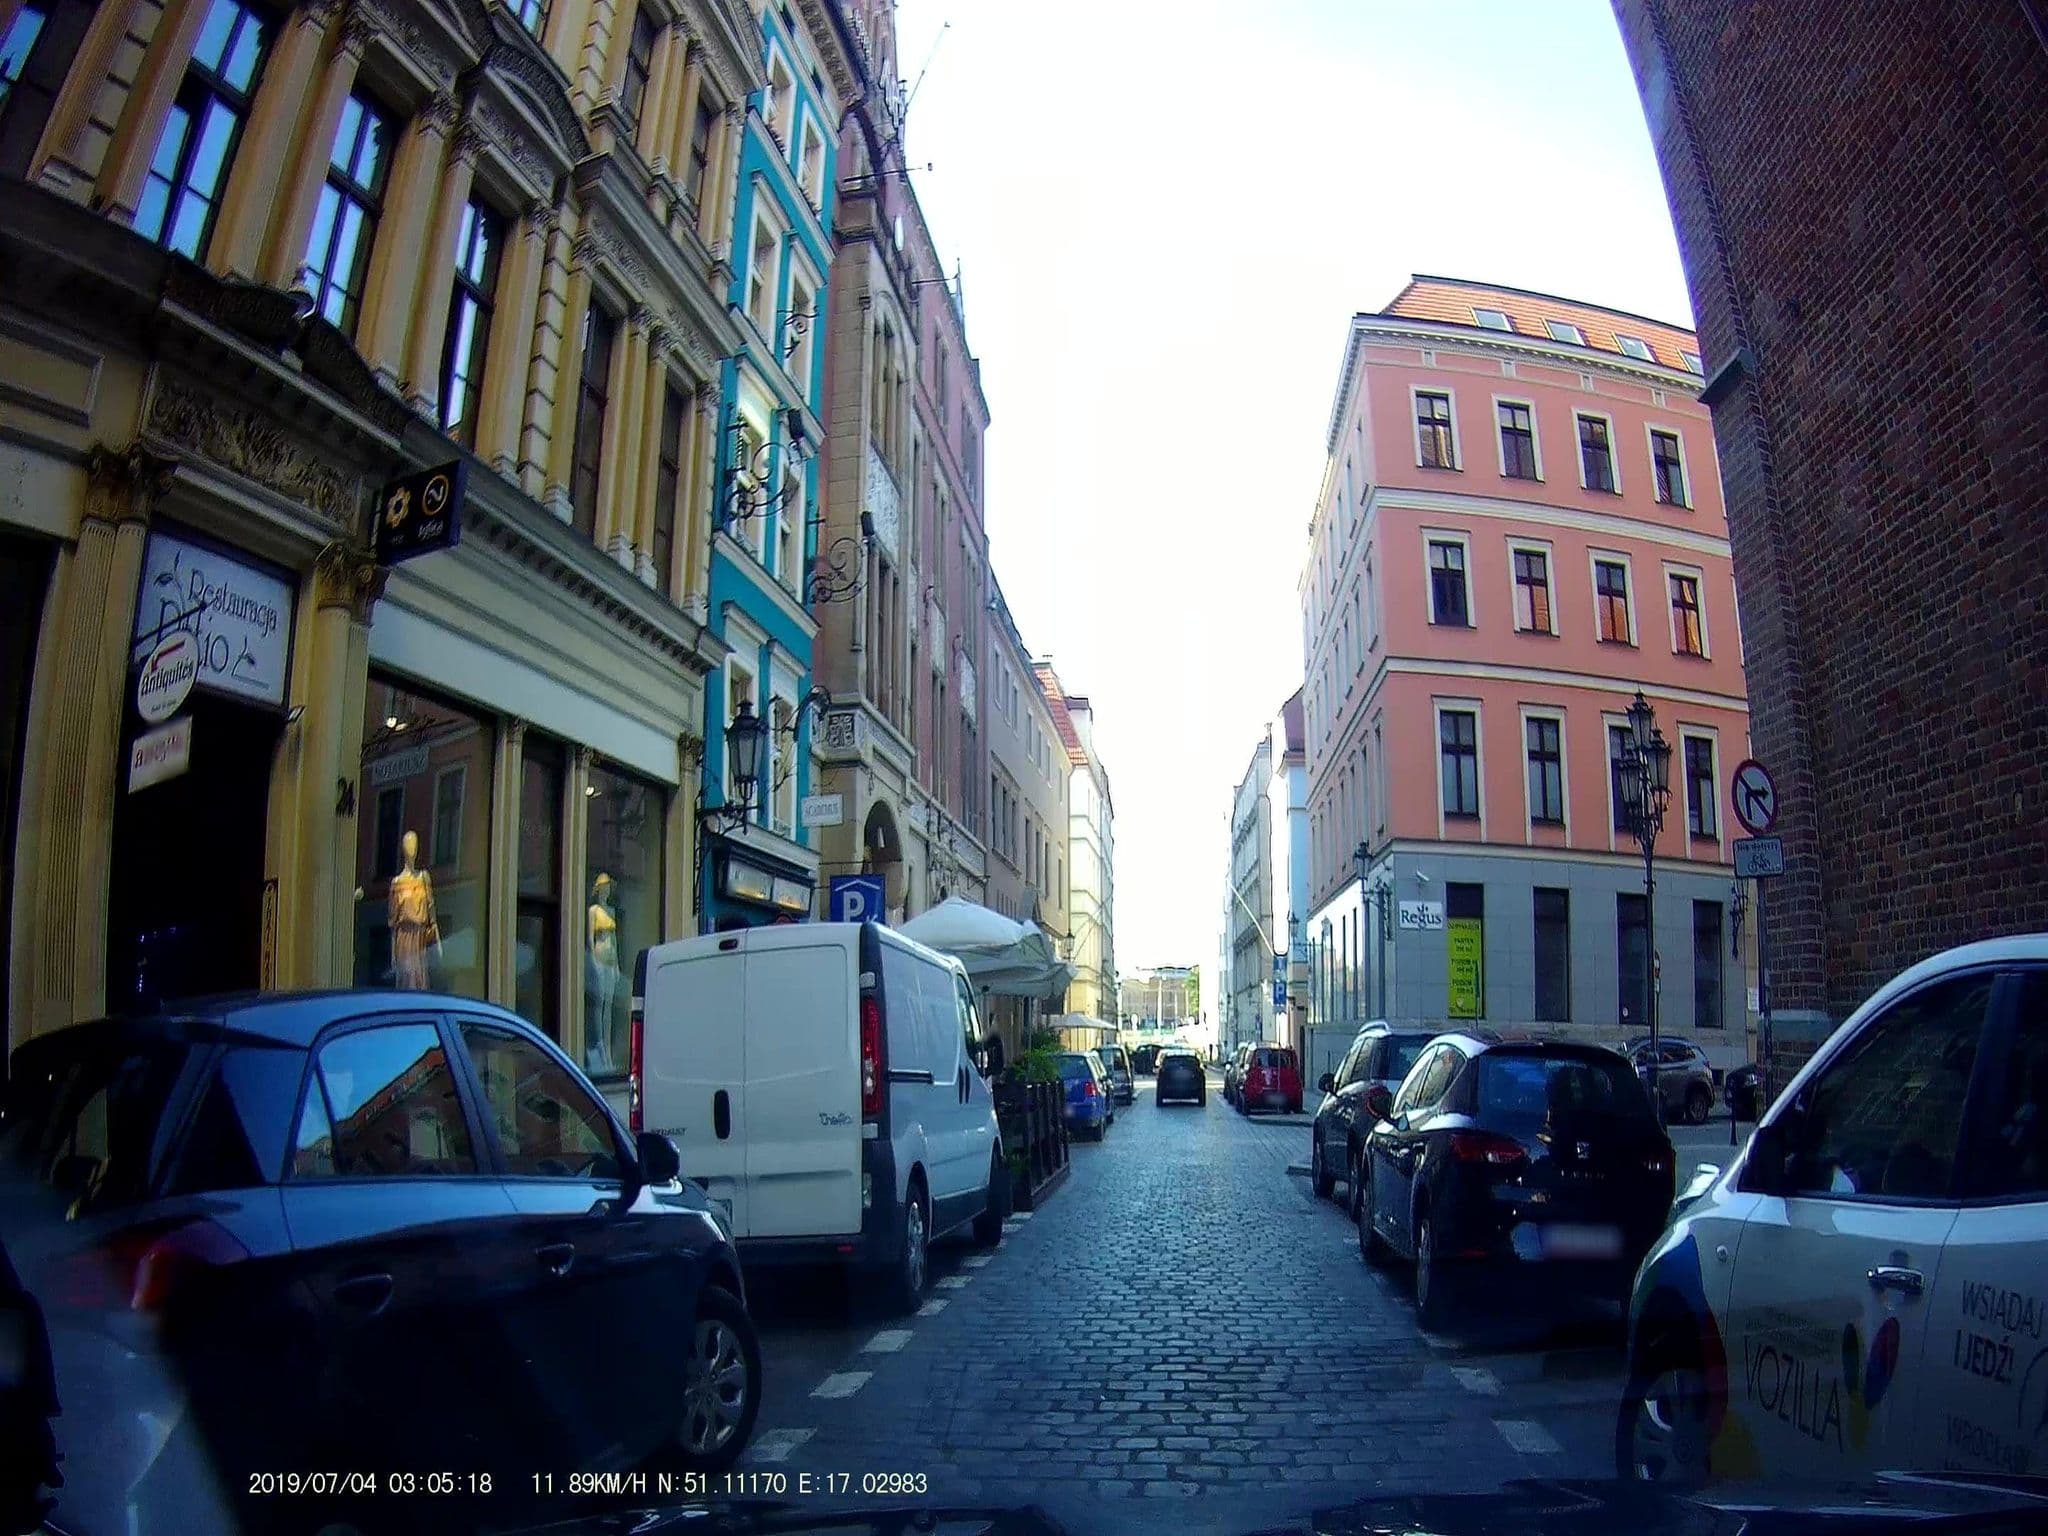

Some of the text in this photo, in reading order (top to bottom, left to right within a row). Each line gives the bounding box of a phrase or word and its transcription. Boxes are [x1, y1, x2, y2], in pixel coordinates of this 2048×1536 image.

[188, 569, 277, 638] Restauracja
[1401, 909, 1442, 930] Regus
[1962, 1279, 2045, 1340] WSIADAJ
[1744, 1335, 1844, 1453] VOZILLA
